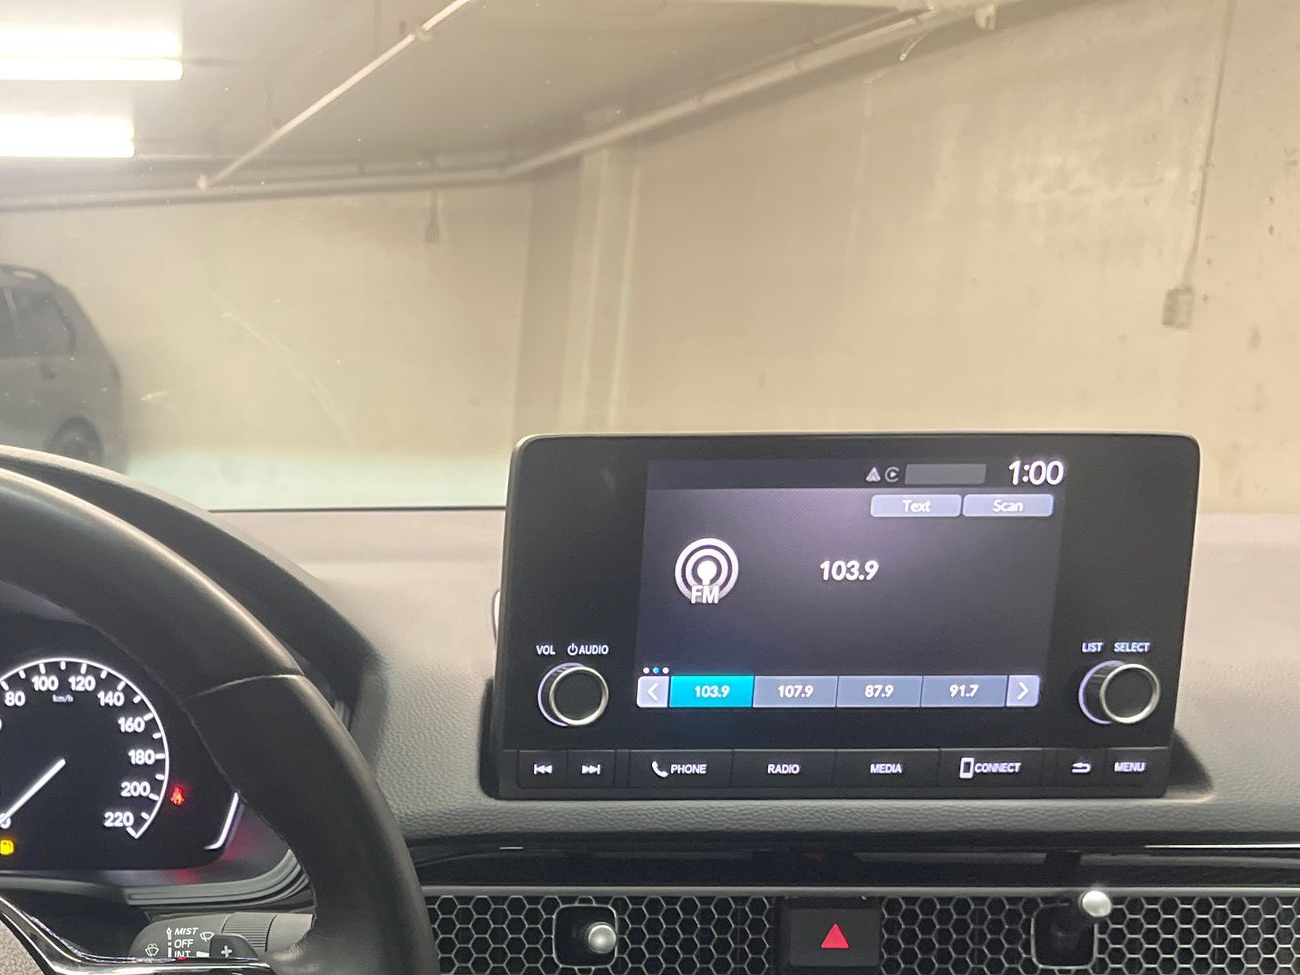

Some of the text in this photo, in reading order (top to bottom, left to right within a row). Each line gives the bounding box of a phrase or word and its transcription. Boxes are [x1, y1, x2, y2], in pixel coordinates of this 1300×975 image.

[1008, 460, 1064, 486] 1:00
[902, 499, 931, 513] Text
[992, 499, 1023, 513] Scan
[819, 560, 879, 581] 103.9
[690, 584, 720, 604] FM
[536, 644, 556, 656] VOL
[578, 643, 609, 656] AUDIO
[1081, 642, 1103, 653] LIST
[1114, 642, 1150, 653] SELECT
[31, 676, 59, 692] 100
[68, 676, 96, 692] 120
[864, 684, 895, 698] 87.9
[949, 684, 980, 698] 91.7
[52, 693, 74, 704] km/h
[694, 685, 731, 698] 103.9
[777, 685, 814, 698] 107.9
[4, 691, 26, 708] 80
[96, 691, 125, 708] 140
[117, 717, 146, 734] 160
[127, 749, 156, 766] 180
[670, 763, 708, 775] PHONE
[767, 763, 801, 775] RADIO
[869, 763, 903, 775] MEDIA
[974, 762, 1022, 774] CONNECT
[1114, 761, 1146, 773] MENU
[120, 782, 151, 798] 200
[104, 812, 135, 828] 220
[174, 927, 199, 936] MIST
[174, 938, 194, 949] OFF
